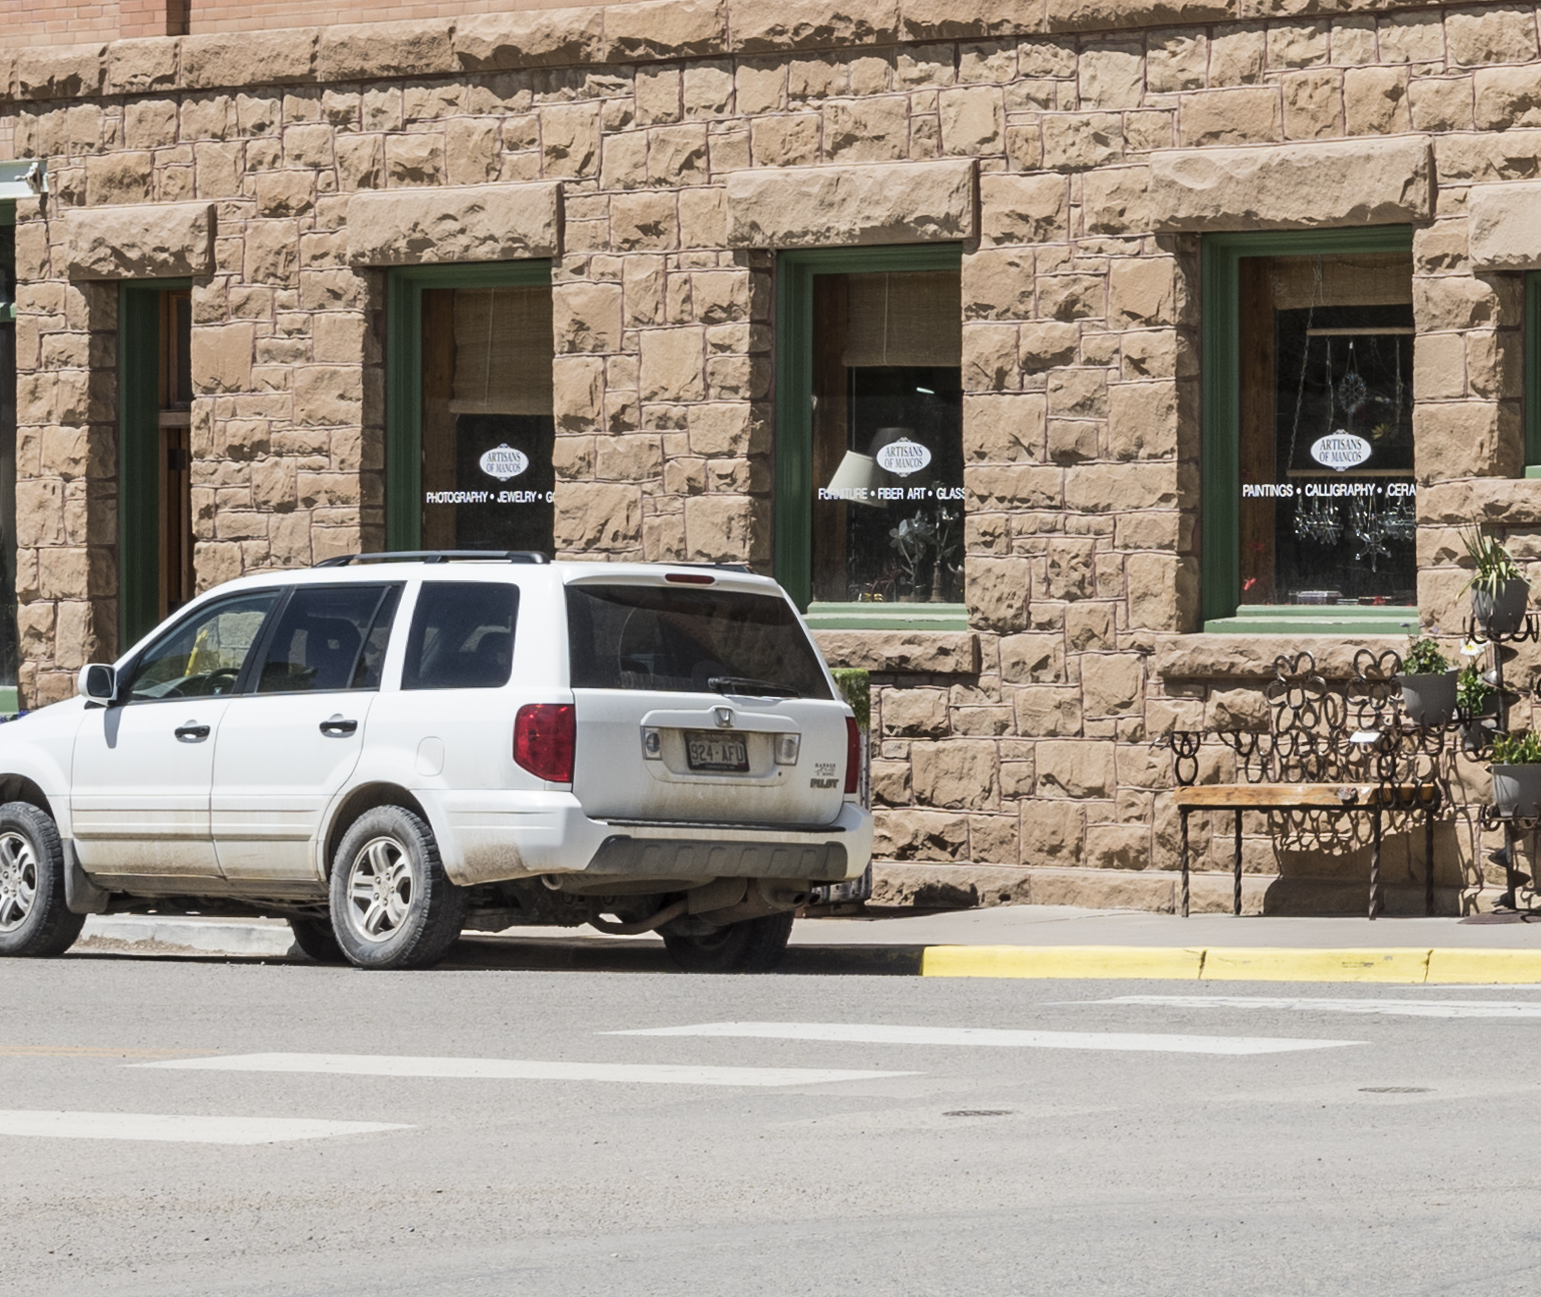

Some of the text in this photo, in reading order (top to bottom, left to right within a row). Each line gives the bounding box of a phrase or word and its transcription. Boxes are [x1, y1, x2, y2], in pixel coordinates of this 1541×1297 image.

[1320, 438, 1362, 451] ARTISANS
[487, 451, 521, 462] ARTISANS
[885, 446, 923, 456] ARTISANS
[1319, 451, 1362, 462] OF MANCOS
[486, 463, 495, 473] OF
[884, 458, 923, 468] OF MANCOS
[877, 487, 904, 500] FIBER
[907, 487, 927, 500] ART
[1242, 484, 1294, 498] PAINTINGS
[1305, 483, 1376, 497] CALLIGRAPHY
[426, 491, 488, 504] PHOTOGRAPHY
[497, 491, 537, 503] JEWELRY
[810, 778, 840, 789] PILOT
